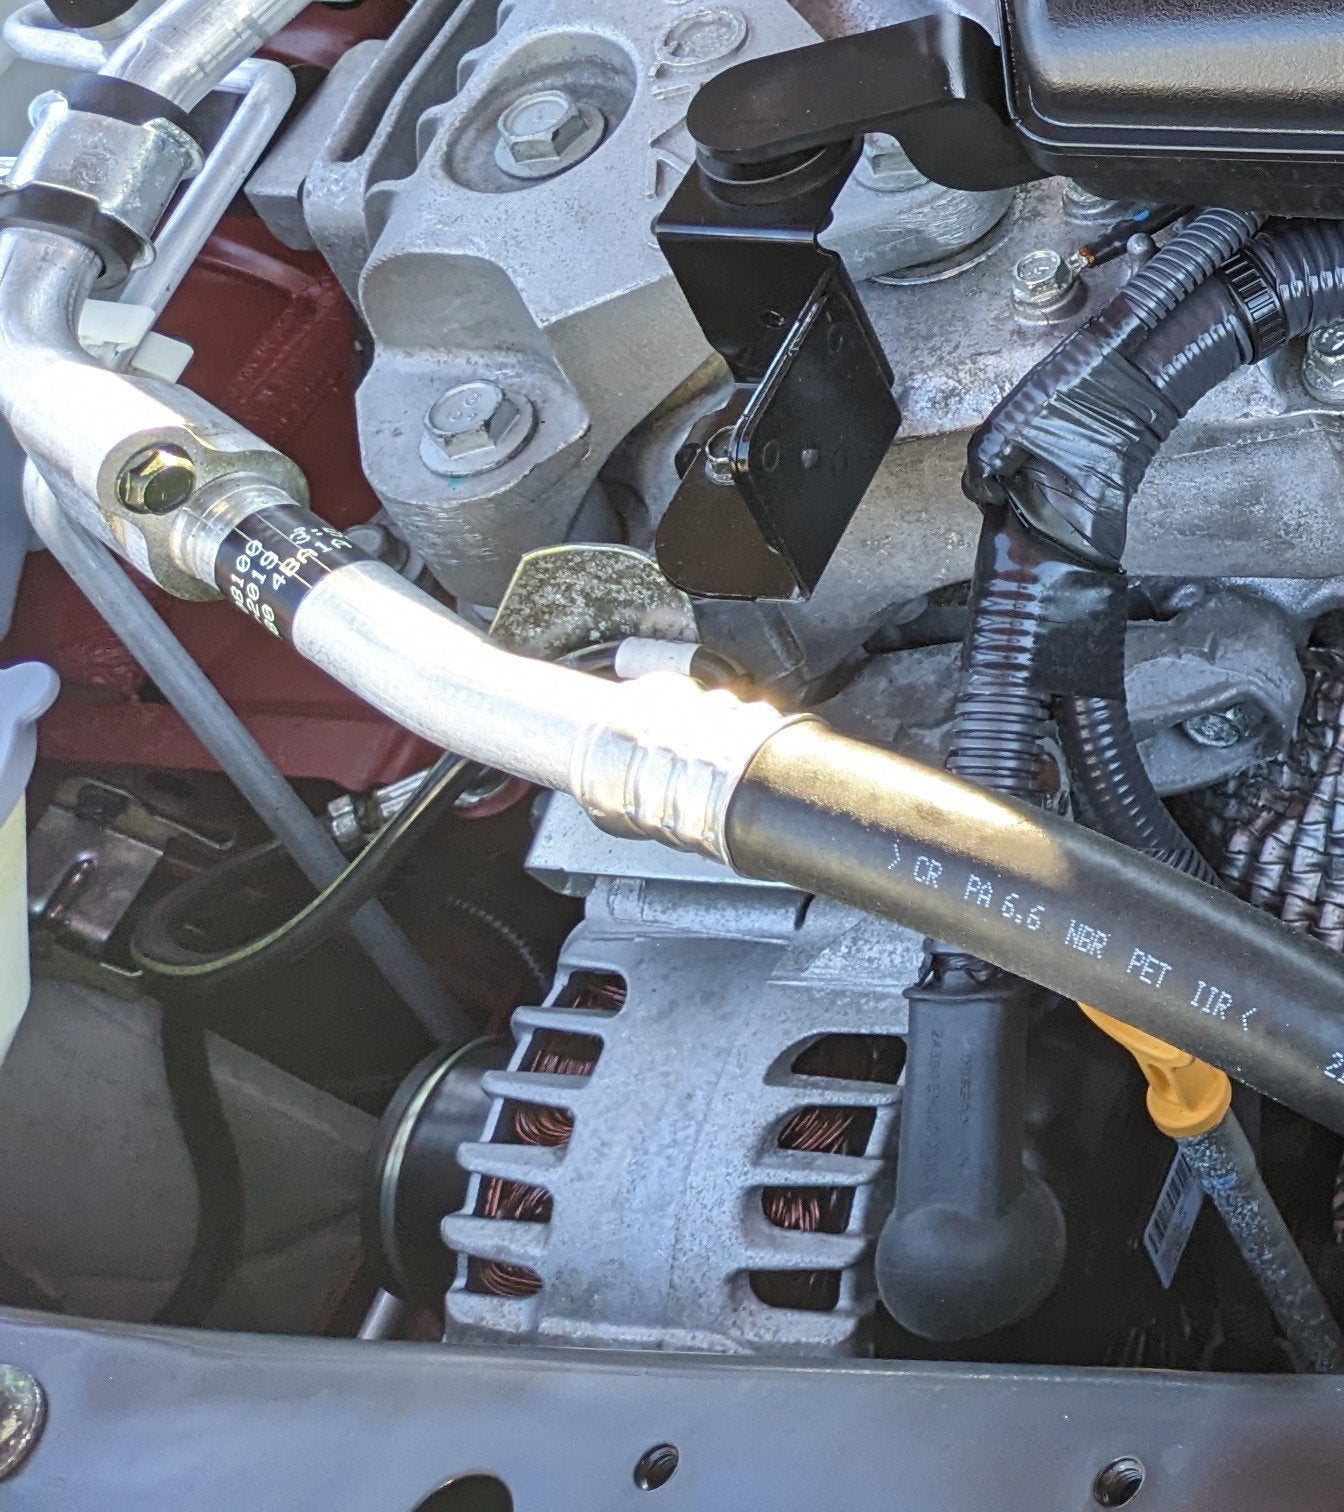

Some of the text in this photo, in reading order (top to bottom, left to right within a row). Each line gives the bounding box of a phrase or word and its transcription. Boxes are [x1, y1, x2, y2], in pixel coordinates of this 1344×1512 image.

[964, 873, 993, 908] PA
[1001, 892, 1046, 931] 6.6
[1064, 919, 1109, 960] NBR
[1126, 947, 1173, 989] PET
